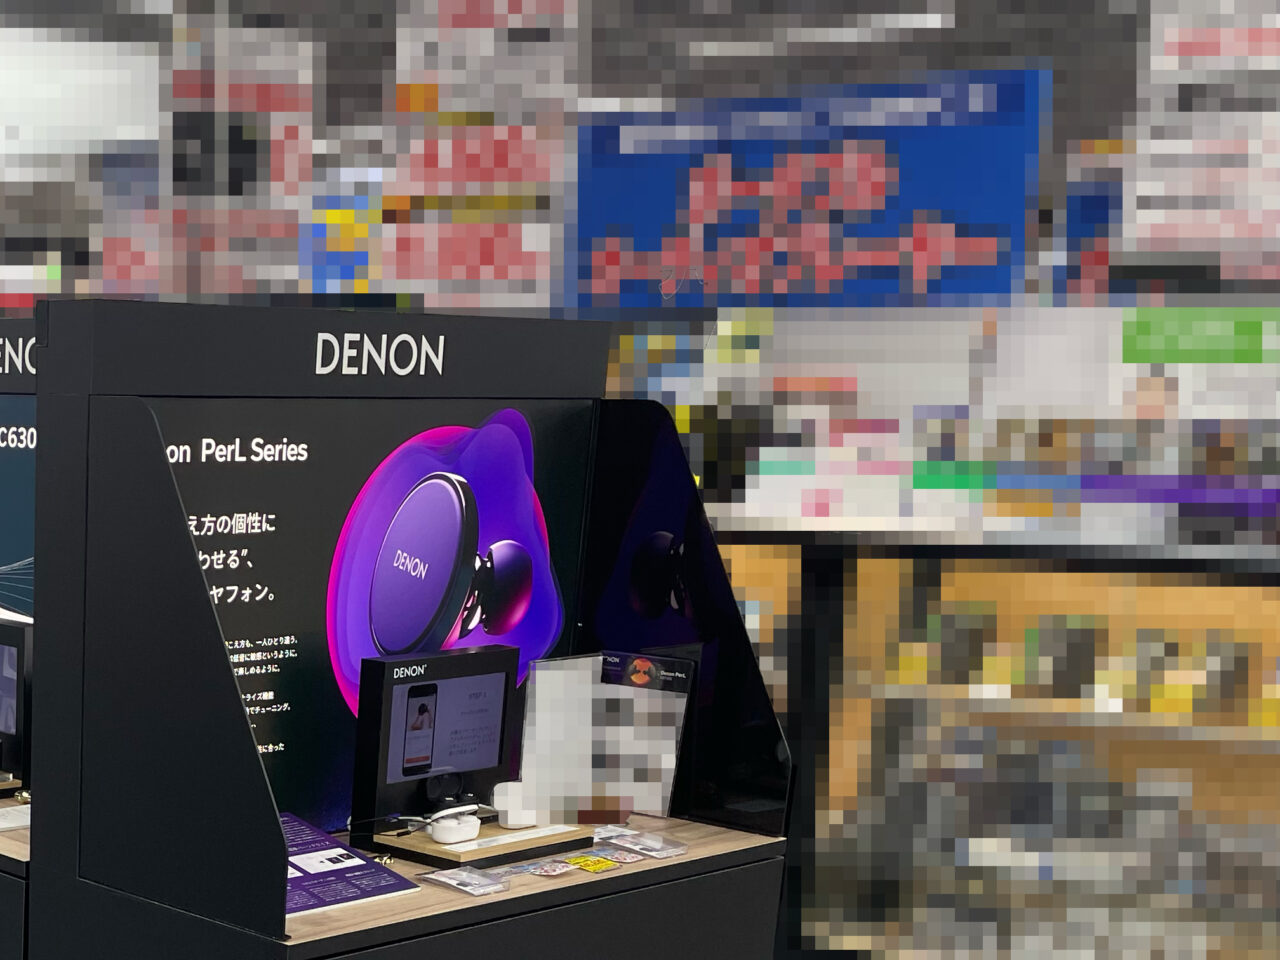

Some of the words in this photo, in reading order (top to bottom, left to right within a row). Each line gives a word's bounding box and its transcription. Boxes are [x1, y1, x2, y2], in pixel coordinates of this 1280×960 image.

[315, 332, 445, 376] DENON
[201, 437, 247, 463] PerL
[250, 437, 308, 462] Series
[393, 549, 429, 580] DENON
[393, 664, 427, 679] DENON
